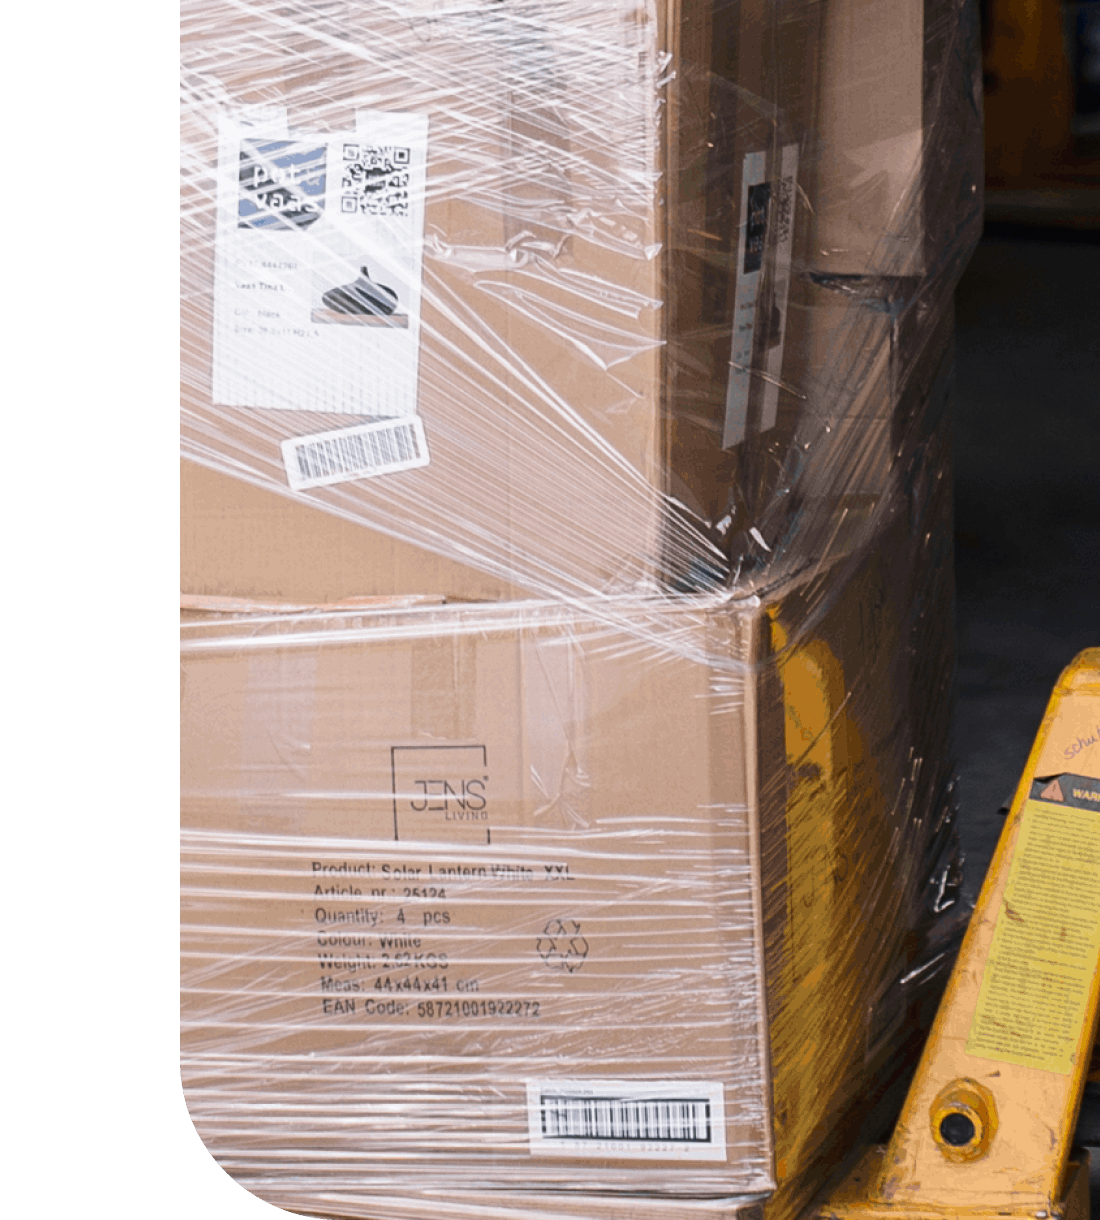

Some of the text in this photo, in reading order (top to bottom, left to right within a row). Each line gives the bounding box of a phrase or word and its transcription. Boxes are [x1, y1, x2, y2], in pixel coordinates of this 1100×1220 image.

[409, 778, 487, 812] JENS
[445, 811, 489, 821] LIVING
[381, 863, 421, 881] Solar
[428, 863, 487, 881] Lantern
[544, 865, 576, 881] XXL
[313, 884, 362, 898] Article
[314, 907, 451, 927] Quantity: 4 pcs
[379, 931, 422, 949] White
[320, 976, 480, 993] Meas: 44x44x41 cm
[322, 998, 356, 1015] EAN
[364, 998, 410, 1016] Code:
